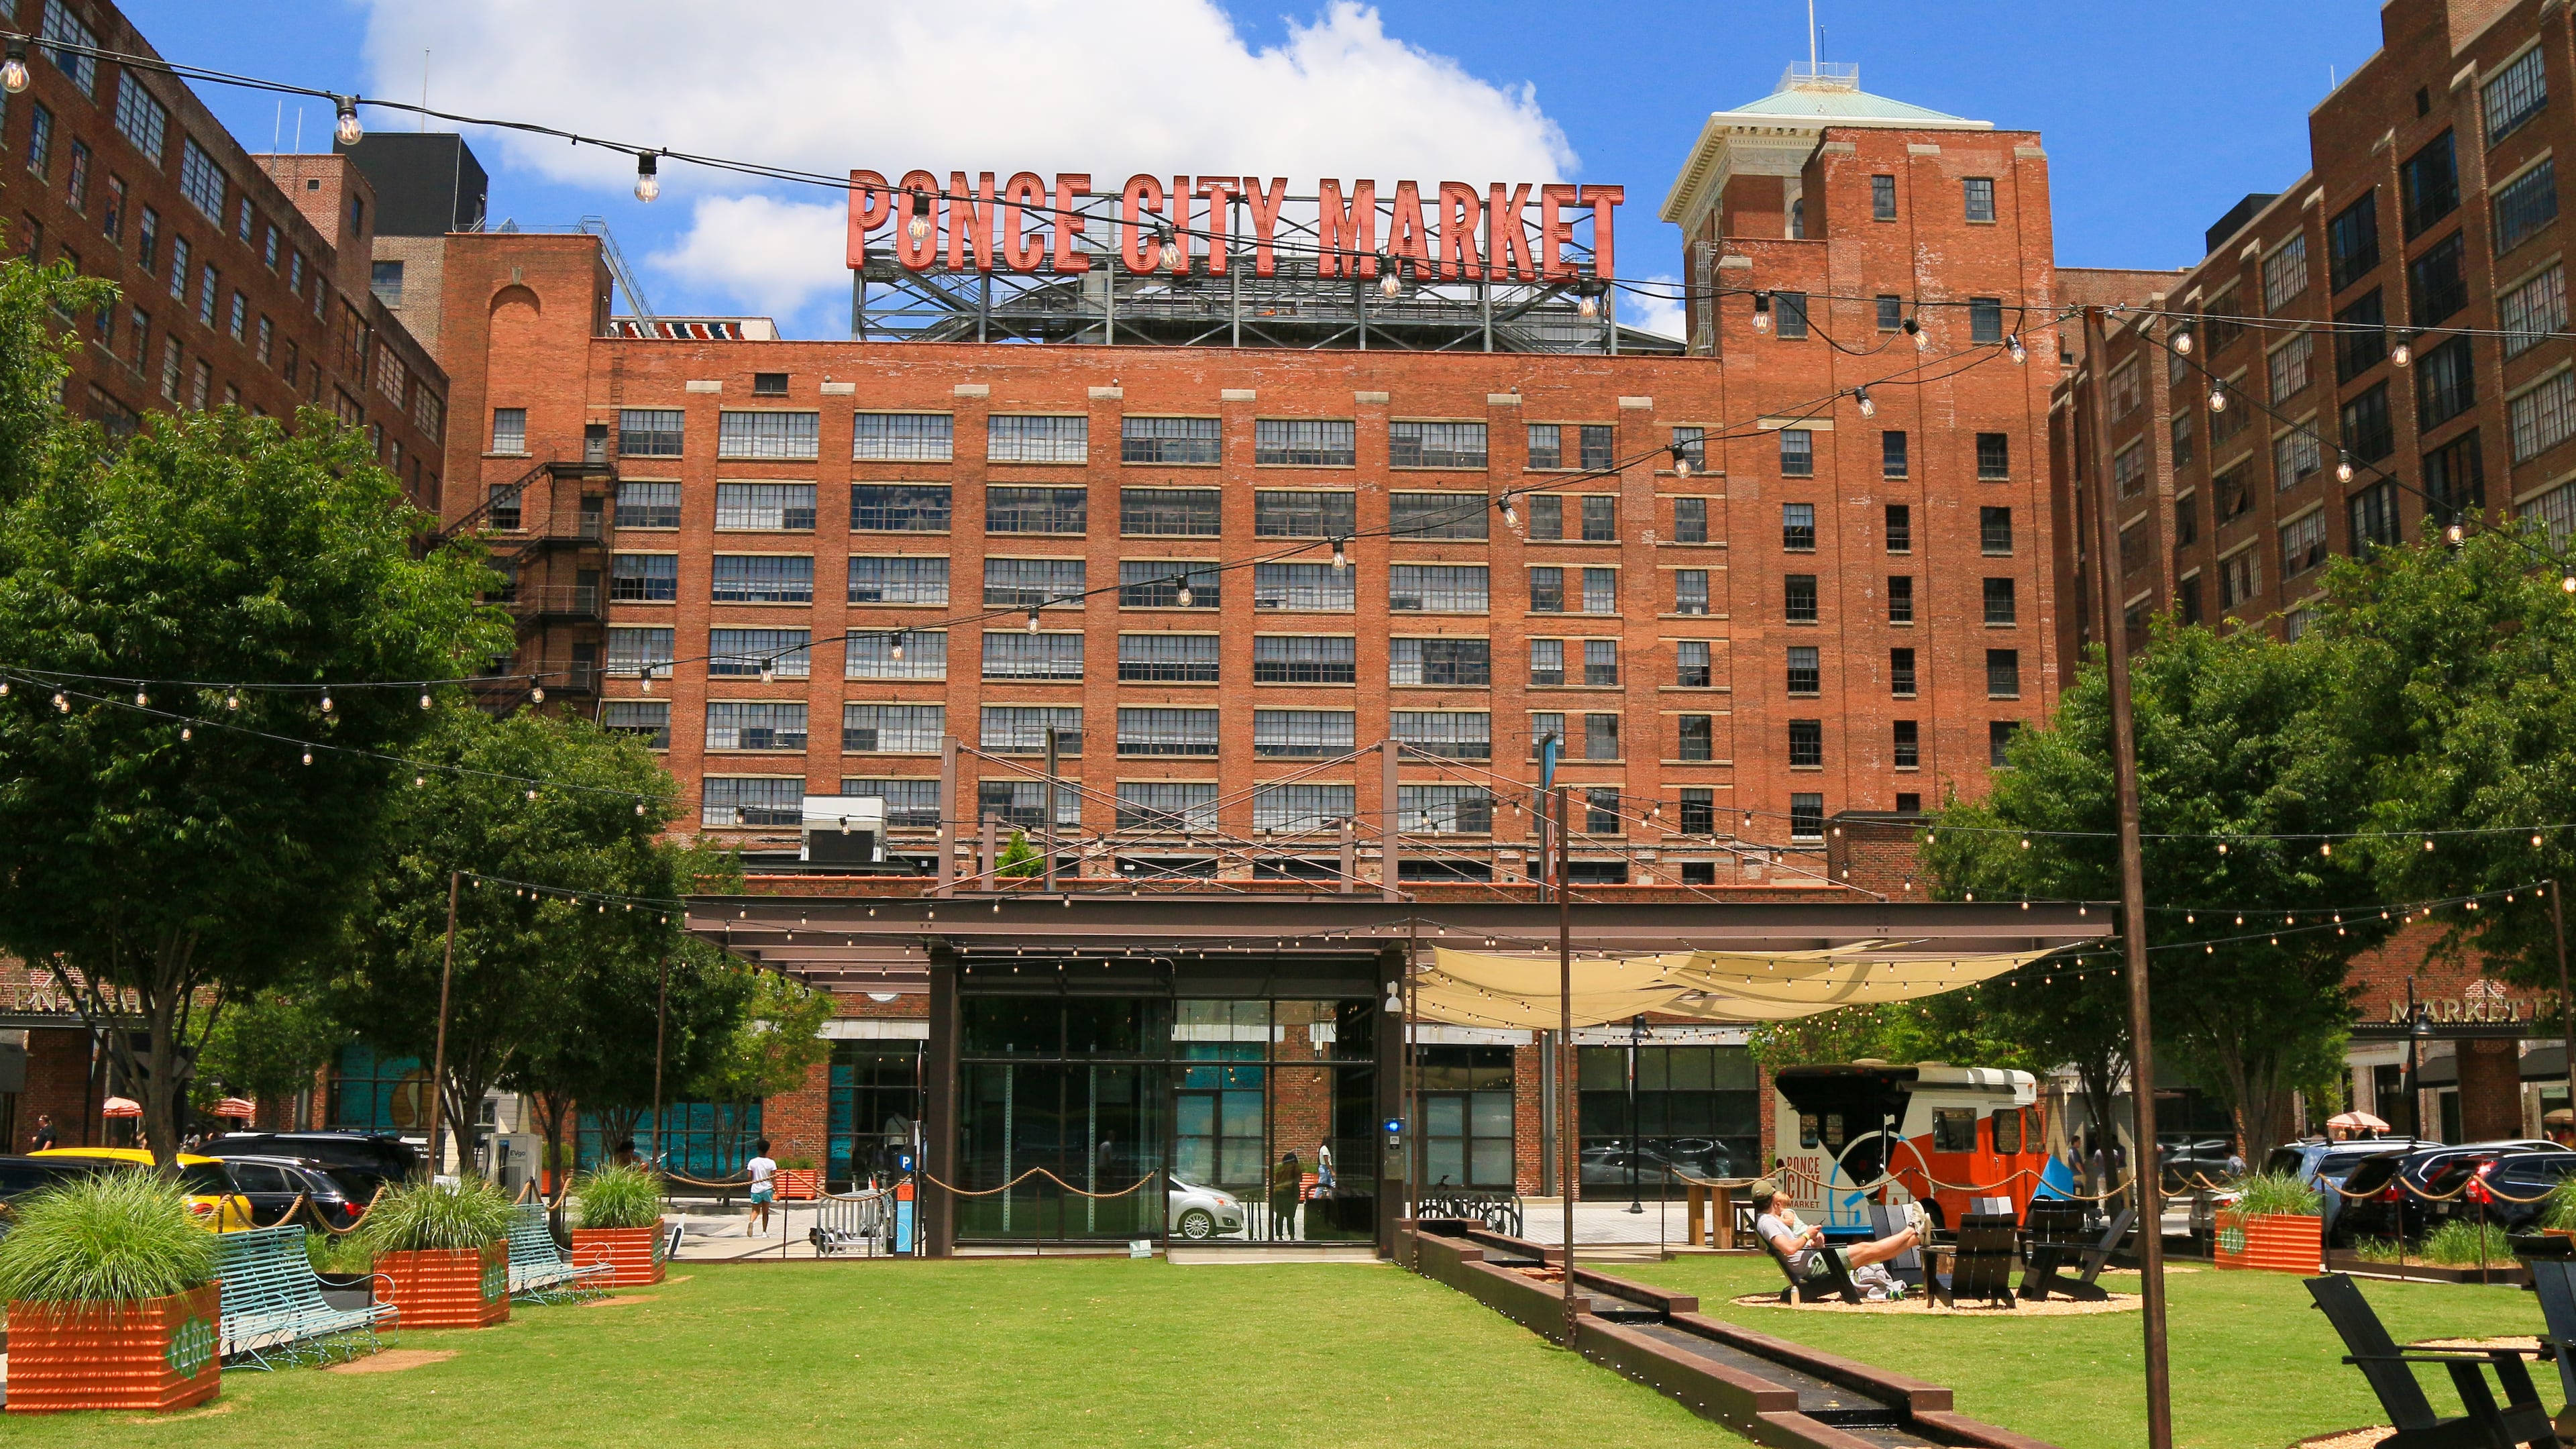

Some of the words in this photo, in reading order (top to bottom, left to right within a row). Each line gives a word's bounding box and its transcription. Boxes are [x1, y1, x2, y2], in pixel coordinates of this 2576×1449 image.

[846, 169, 1091, 273] PONCE
[1122, 173, 1288, 278] CITY
[1318, 178, 1624, 284] MARKET
[2389, 998, 2524, 1023] MARKET
[511, 1150, 526, 1158] EVgo
[902, 1156, 910, 1169] P
[1787, 1156, 1820, 1174] PONCE
[1787, 1174, 1820, 1199] CITY
[1787, 1201, 1820, 1209] MARKET
